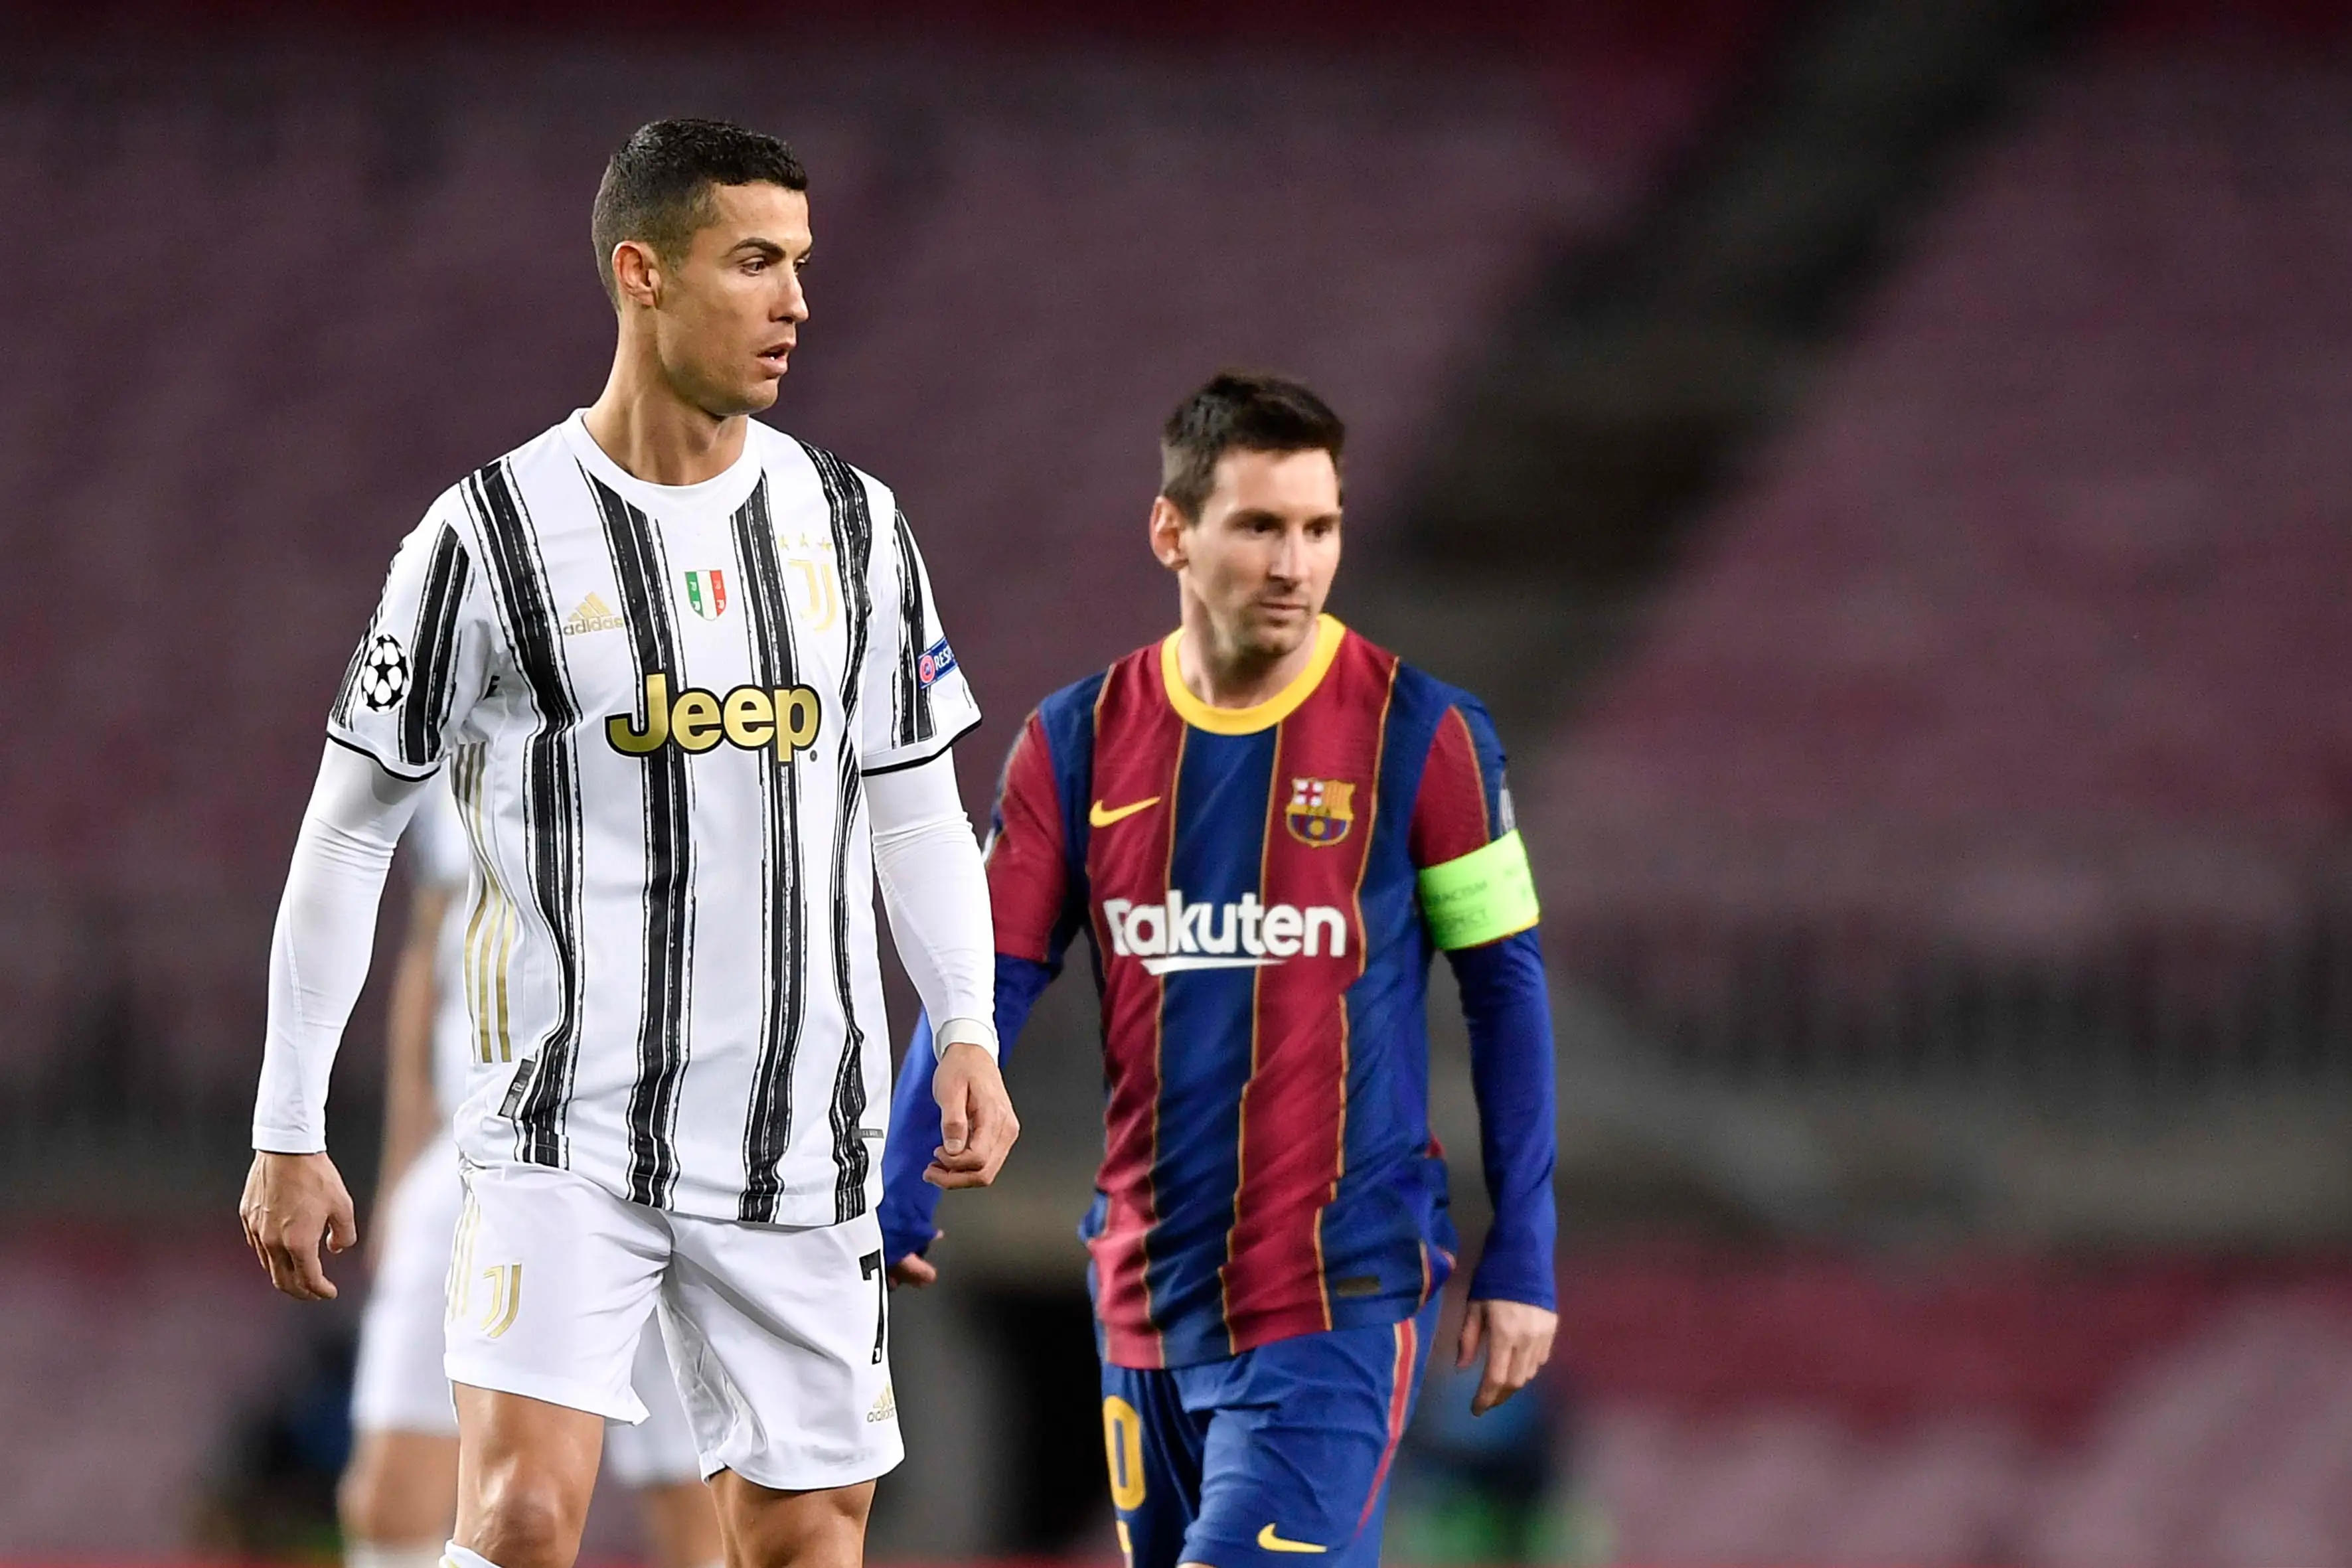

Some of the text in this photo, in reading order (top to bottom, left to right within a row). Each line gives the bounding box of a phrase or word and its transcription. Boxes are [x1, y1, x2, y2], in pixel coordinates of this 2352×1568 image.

[562, 615, 624, 636] adidas
[605, 672, 822, 763] Jeep
[1103, 890, 1347, 957] Rakuten
[859, 1249, 884, 1365] 7
